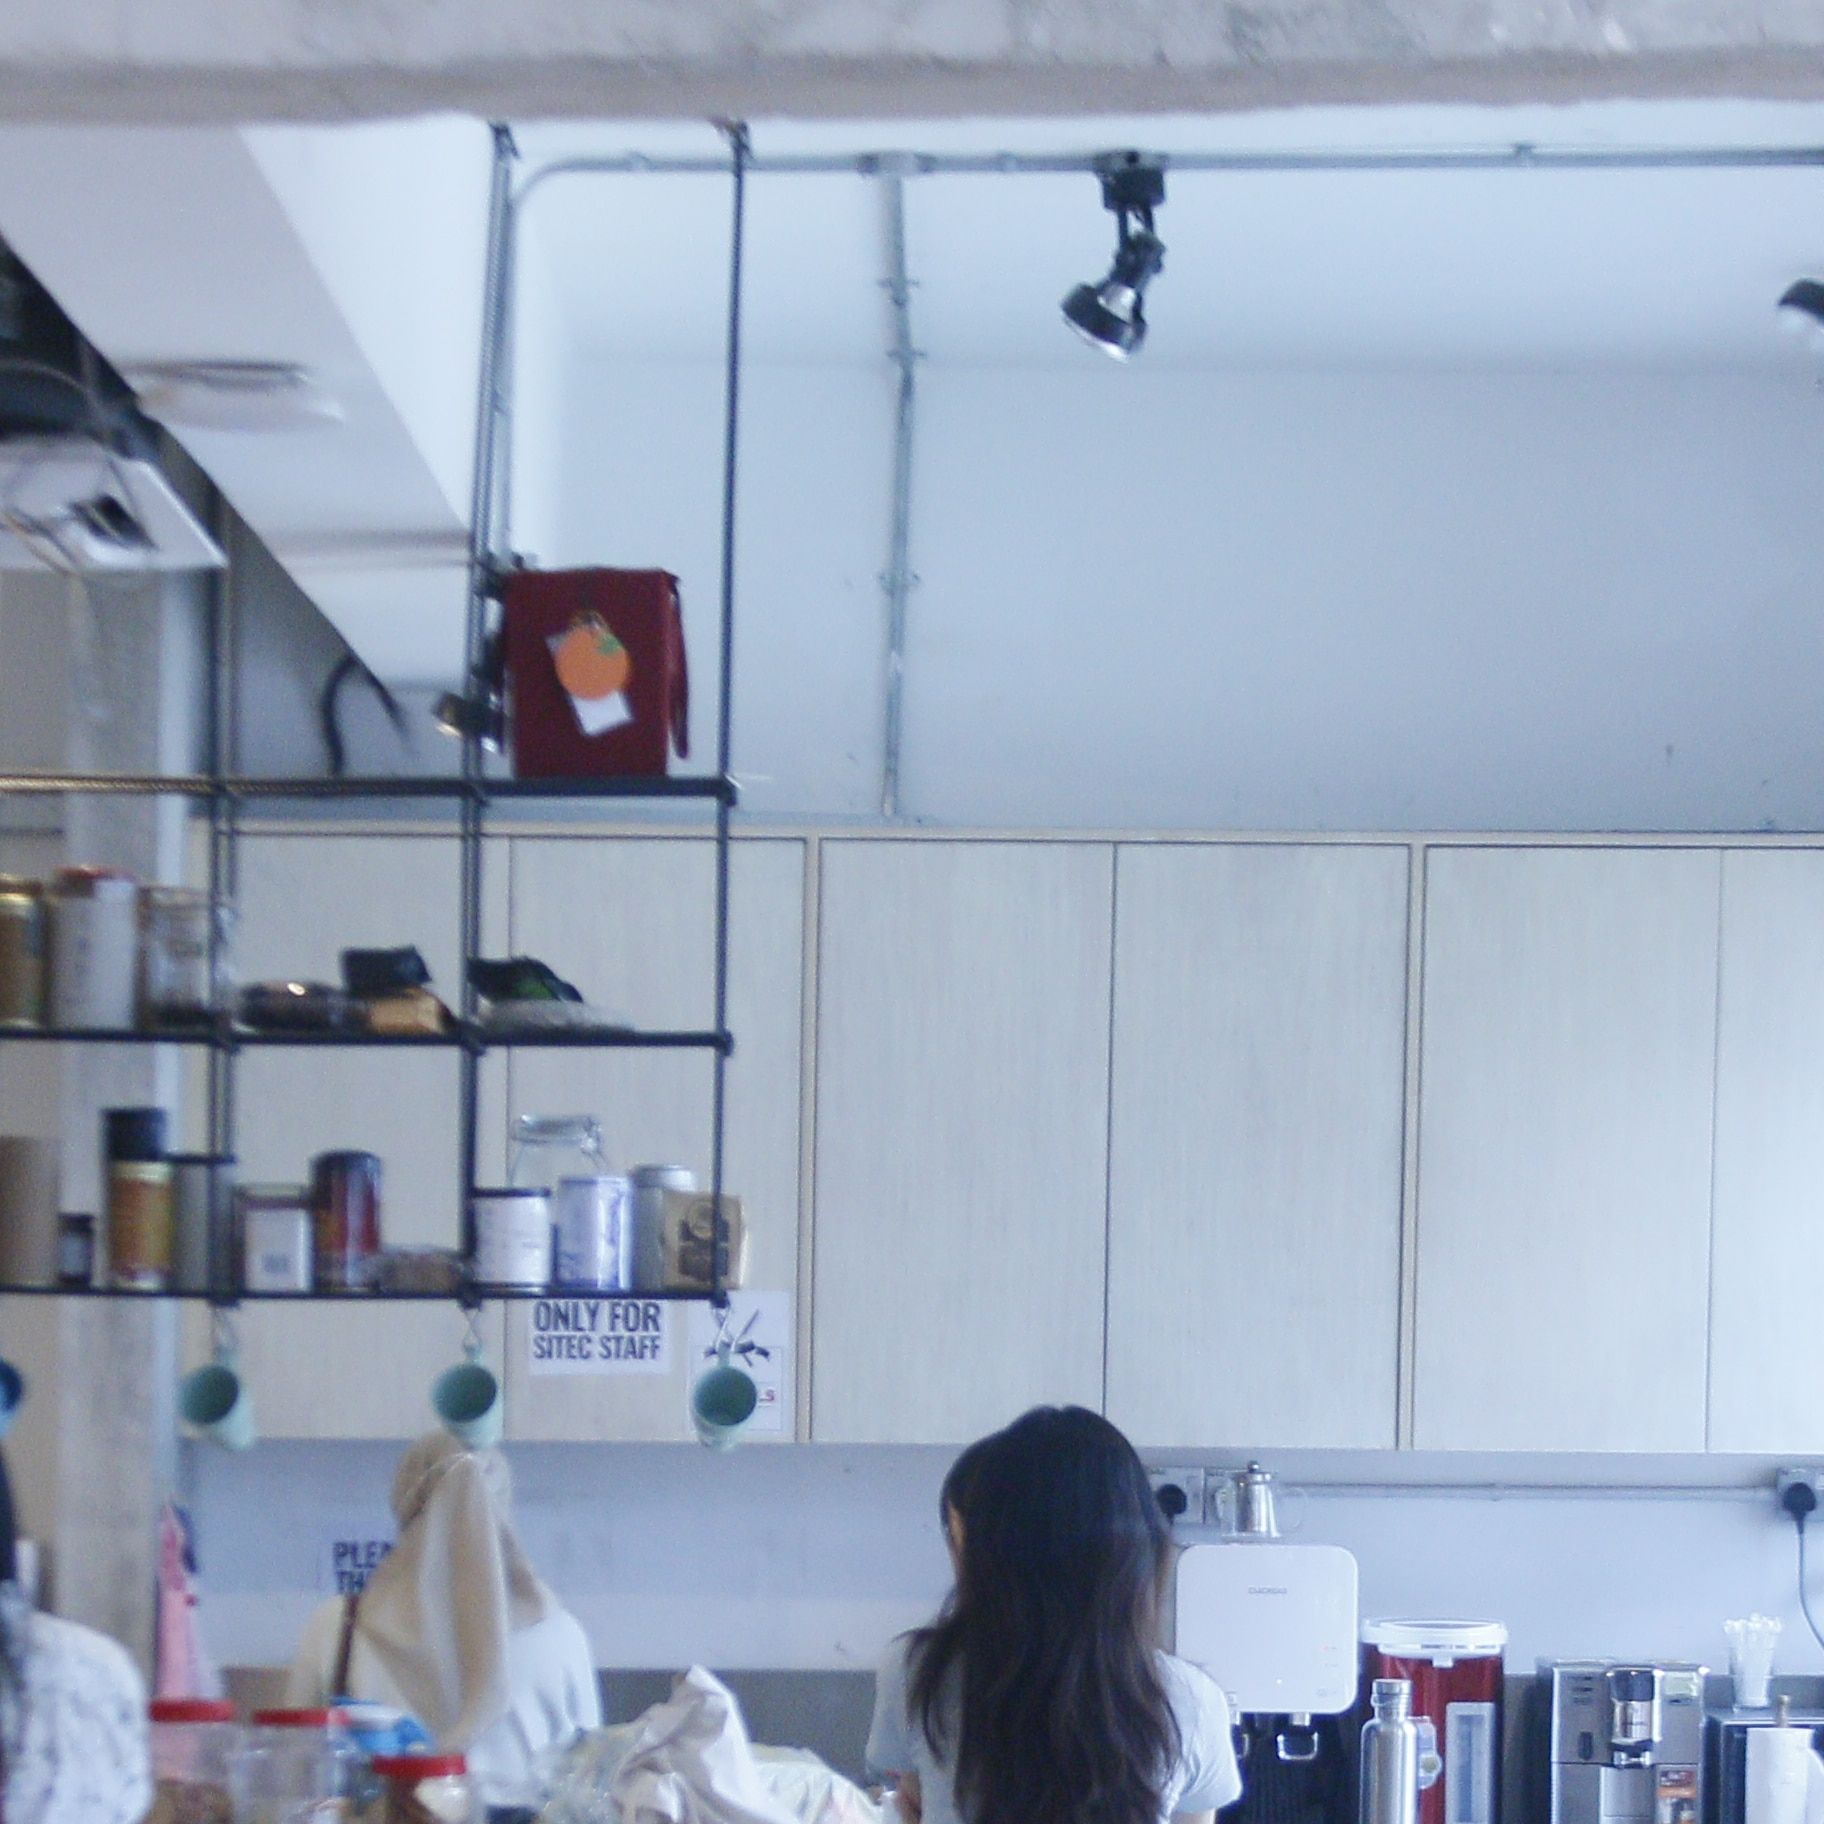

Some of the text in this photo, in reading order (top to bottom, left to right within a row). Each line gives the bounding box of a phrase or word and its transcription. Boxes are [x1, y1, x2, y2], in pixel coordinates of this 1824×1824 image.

[533, 1300, 662, 1333] ONLY FOR
[532, 1334, 662, 1360] SITEC STAFF
